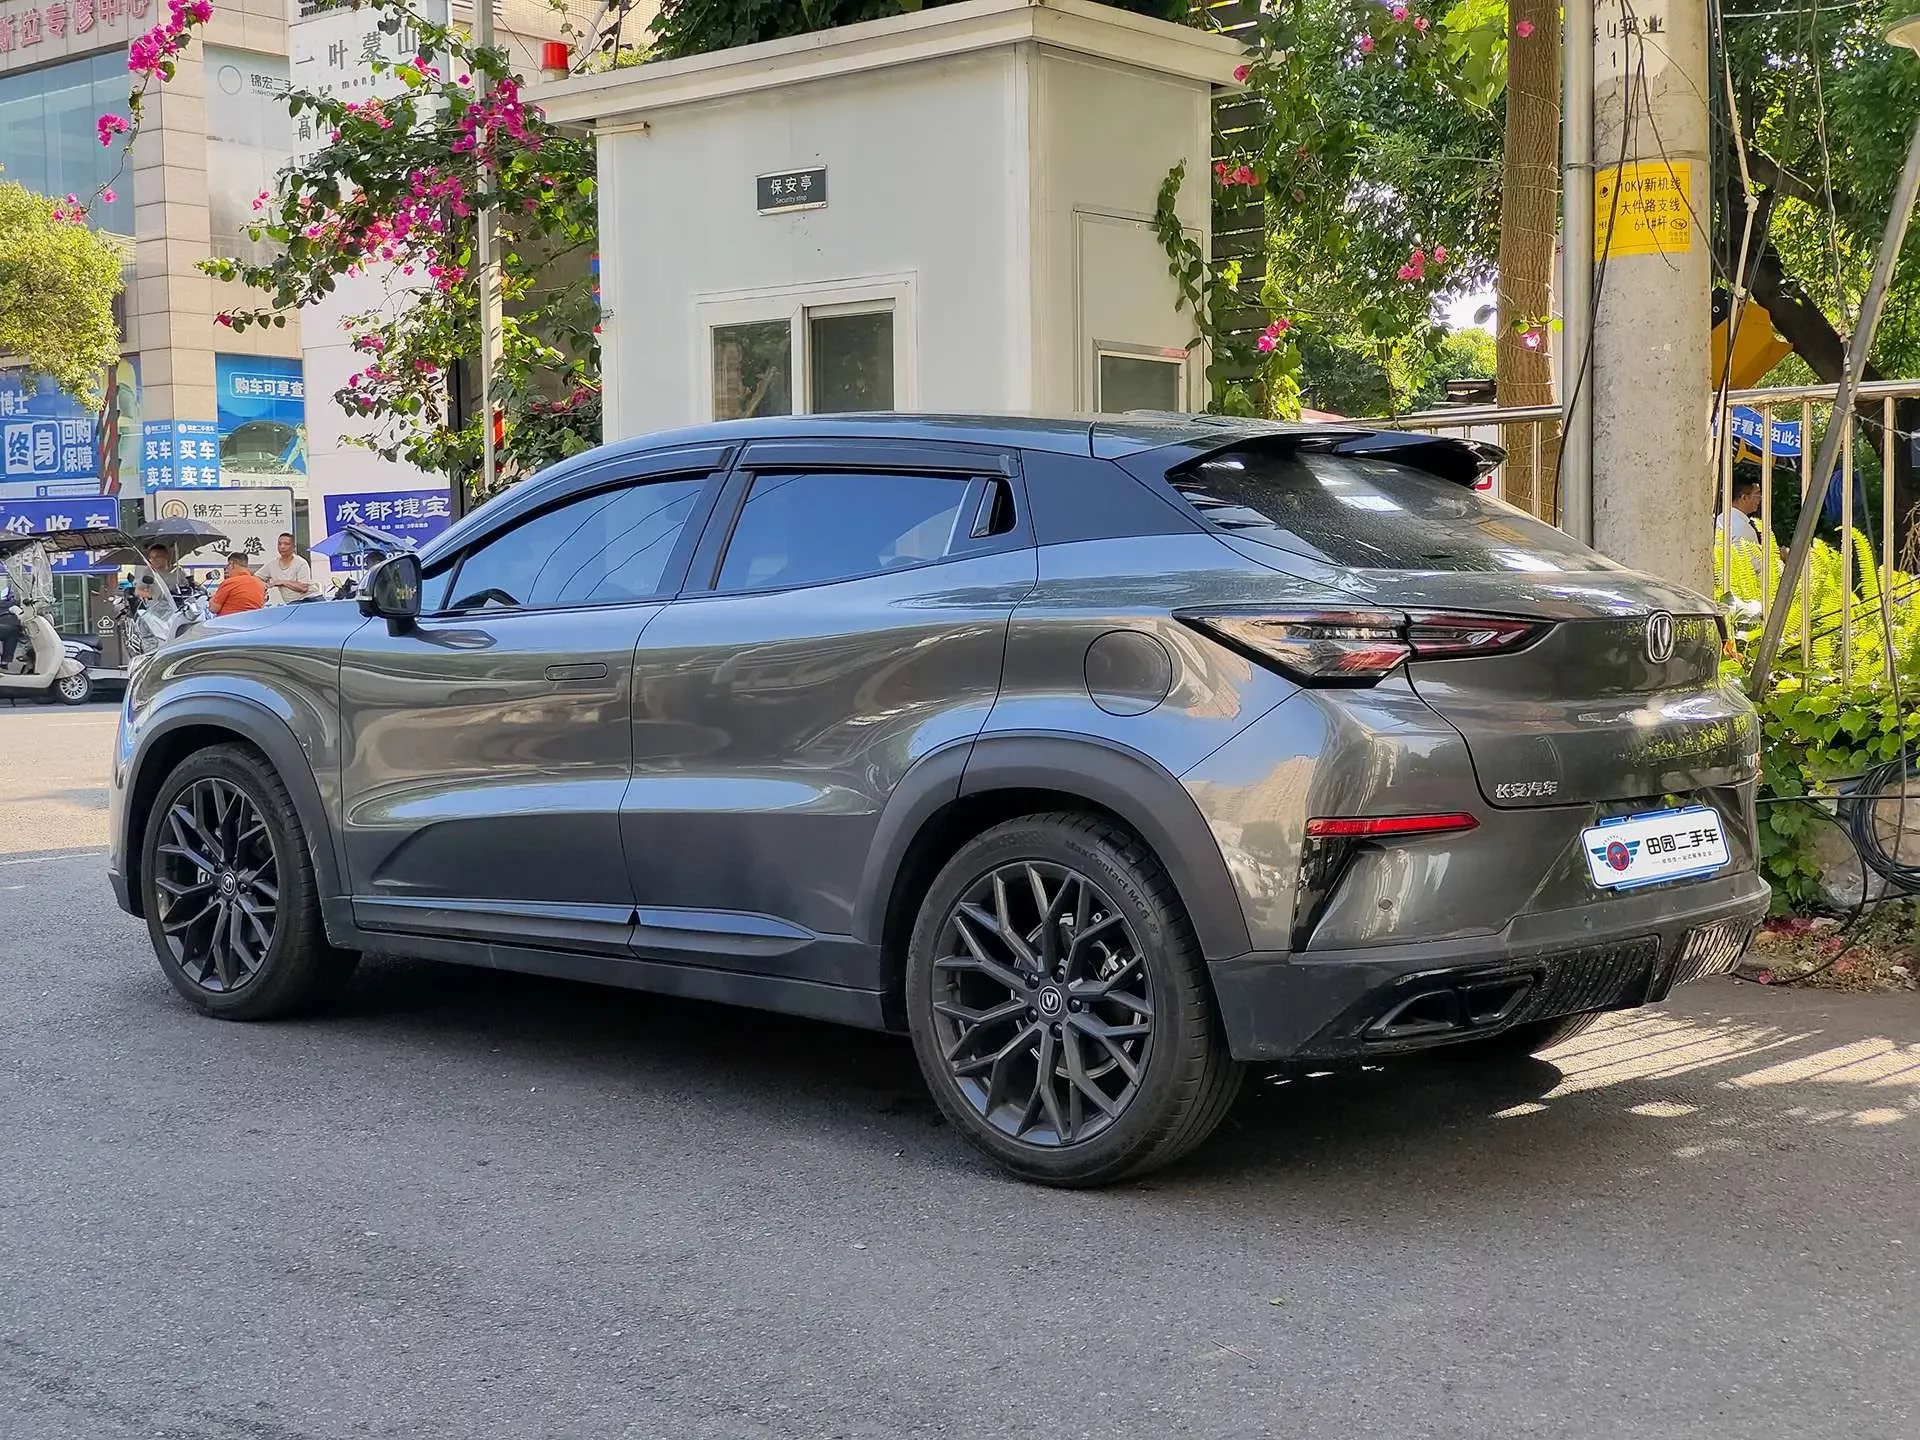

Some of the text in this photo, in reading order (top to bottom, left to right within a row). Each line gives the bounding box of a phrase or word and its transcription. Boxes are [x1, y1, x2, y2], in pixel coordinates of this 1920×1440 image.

[771, 175, 812, 195] 保安亭
[1620, 197, 1681, 216] 大件路支线
[62, 420, 91, 445] 回购
[62, 445, 93, 472] 保障
[146, 440, 172, 460] 买车
[180, 440, 216, 460] 买车
[147, 466, 173, 486] 卖车
[181, 466, 217, 486] 卖车
[193, 503, 284, 519] 锦宏二手名车
[336, 496, 450, 523] 成都捷宝
[1496, 780, 1558, 799] 长安汽车
[1646, 828, 1719, 855] 田园二手车
